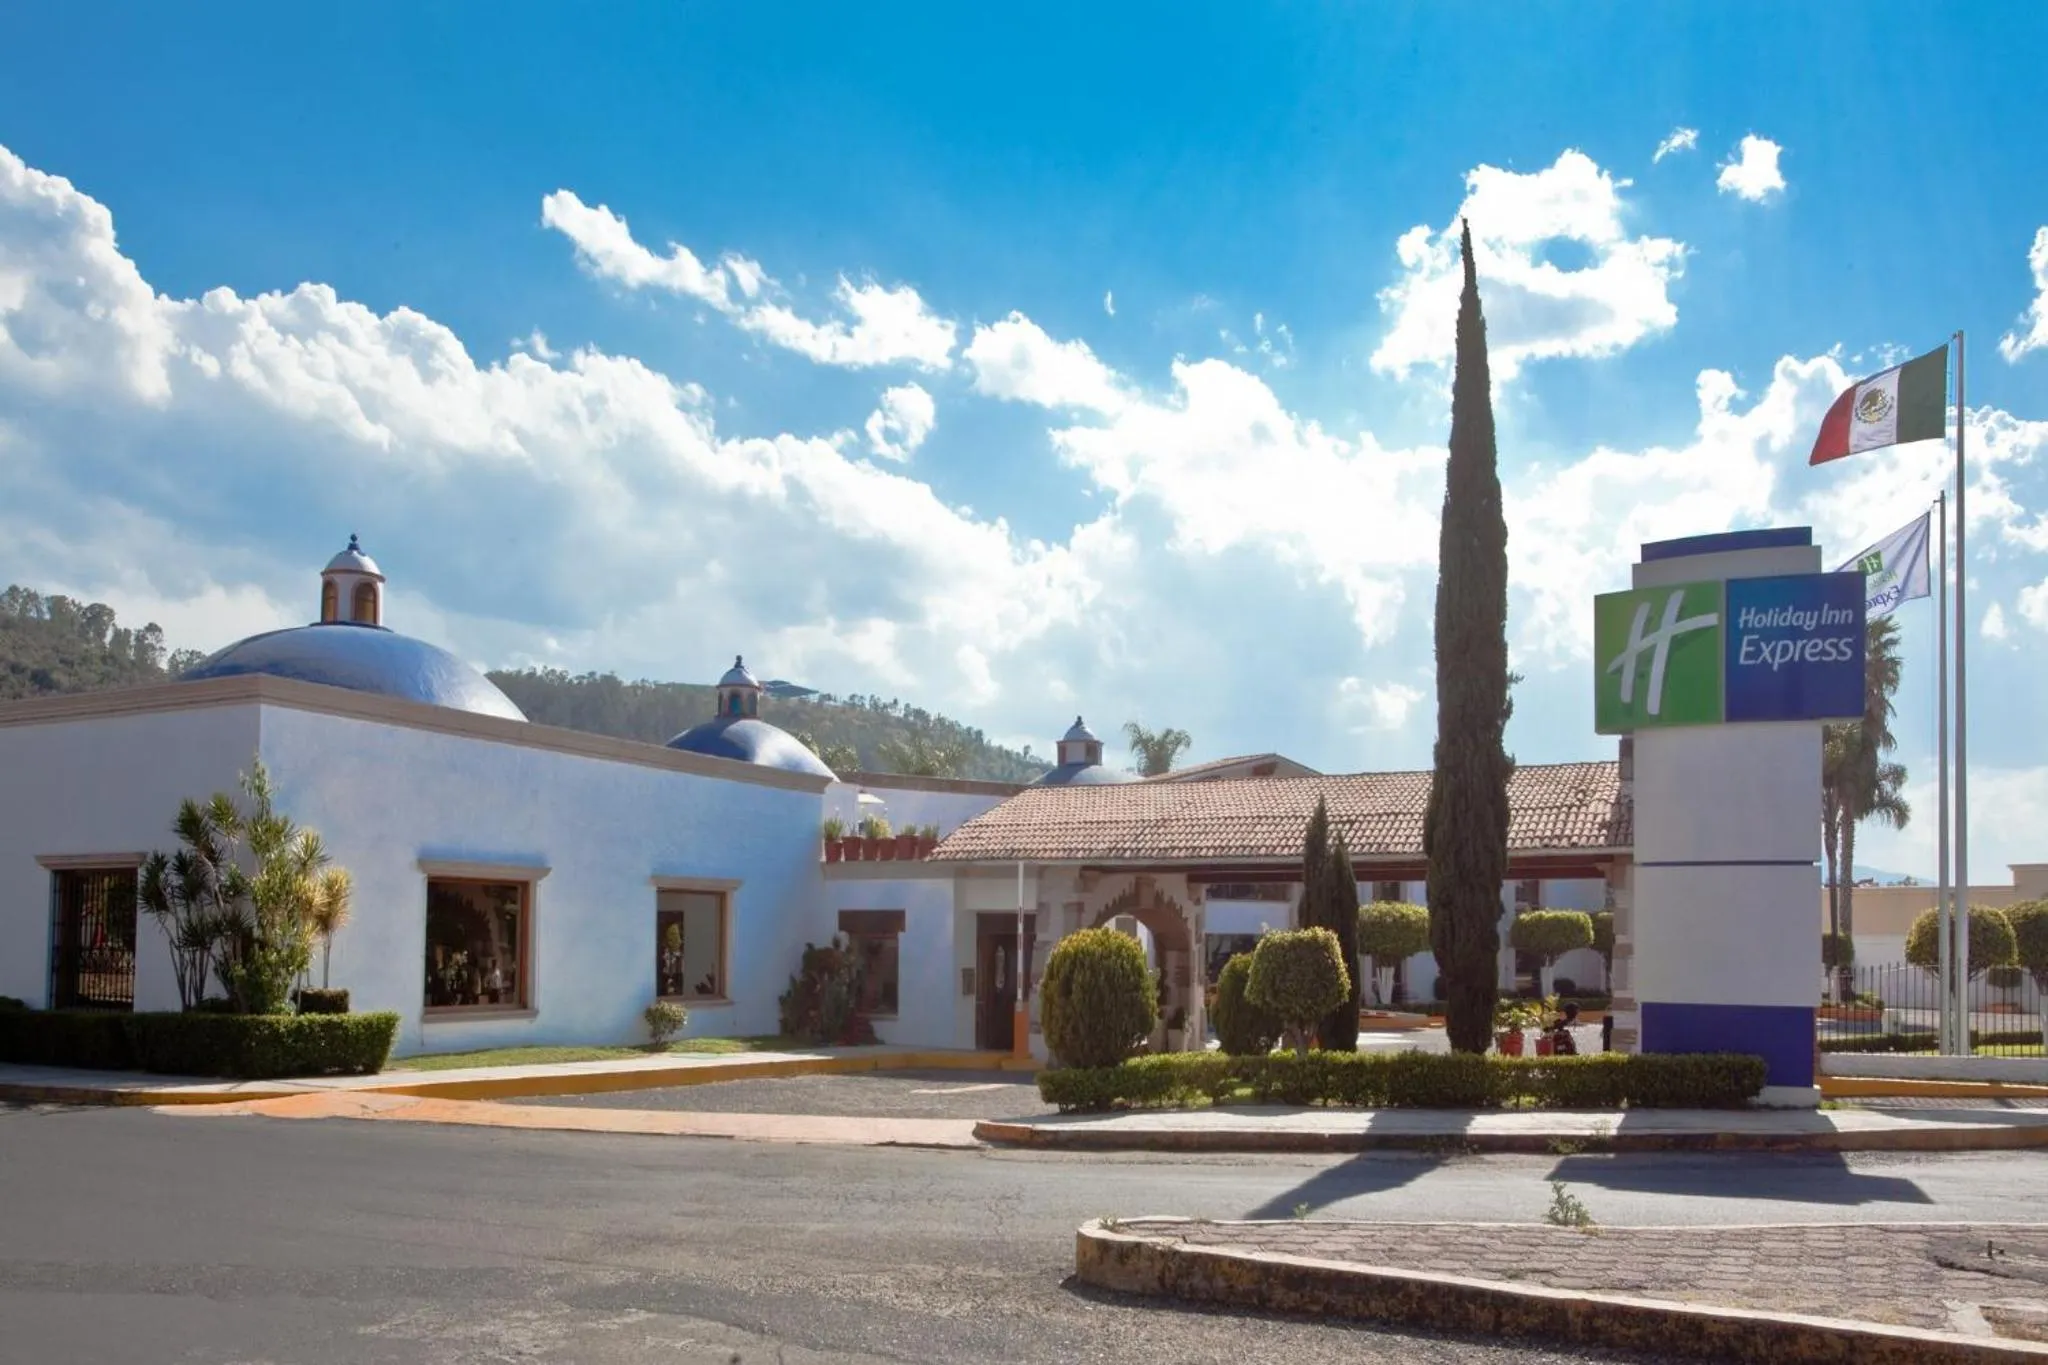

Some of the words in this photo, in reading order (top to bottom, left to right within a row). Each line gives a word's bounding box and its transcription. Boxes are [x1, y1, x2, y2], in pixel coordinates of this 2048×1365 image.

[1739, 604, 1818, 631] Holiday
[1821, 602, 1854, 625] Inn
[1606, 589, 1719, 715] H
[1739, 635, 1854, 672] Express
